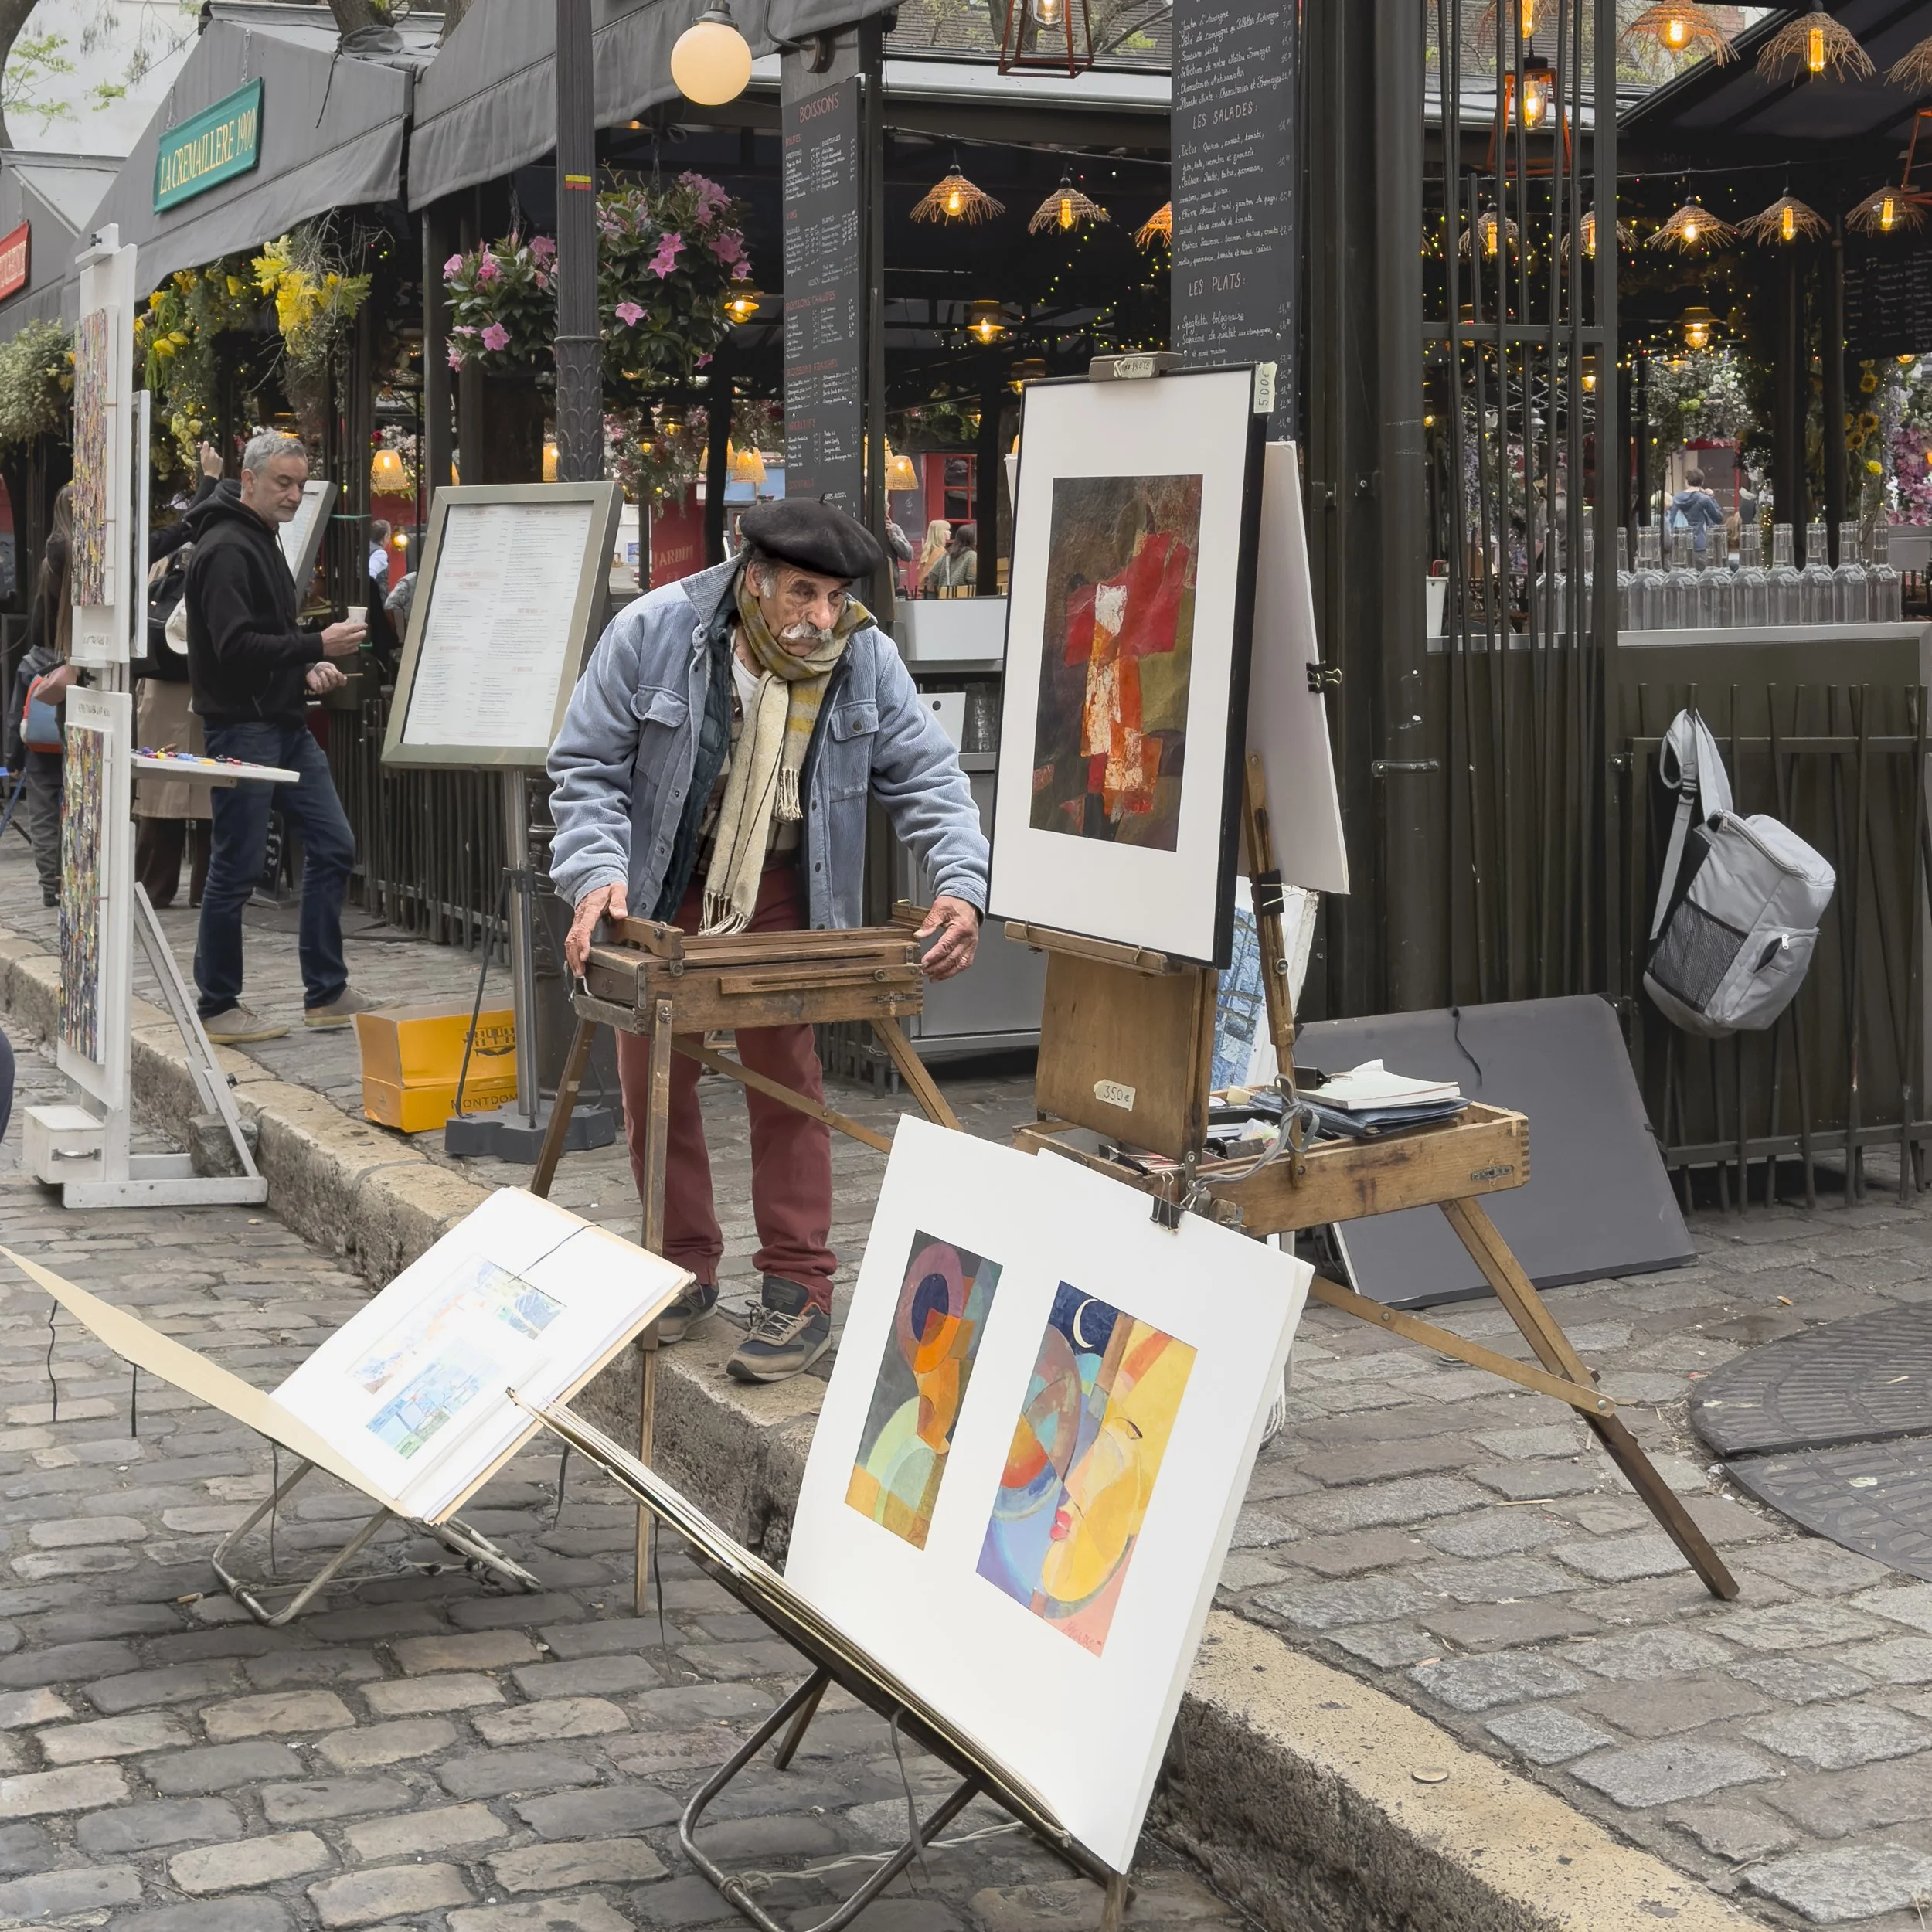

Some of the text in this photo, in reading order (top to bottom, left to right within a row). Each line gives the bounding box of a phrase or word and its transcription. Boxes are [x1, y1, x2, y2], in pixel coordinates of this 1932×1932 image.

[799, 92, 839, 123] BOISSONS
[1192, 114, 1206, 130] LES
[160, 155, 171, 195] LA
[236, 107, 256, 156] 1900
[1189, 279, 1203, 297] LES
[1182, 312, 1208, 335] Spaghetti
[1258, 369, 1270, 406] 500€
